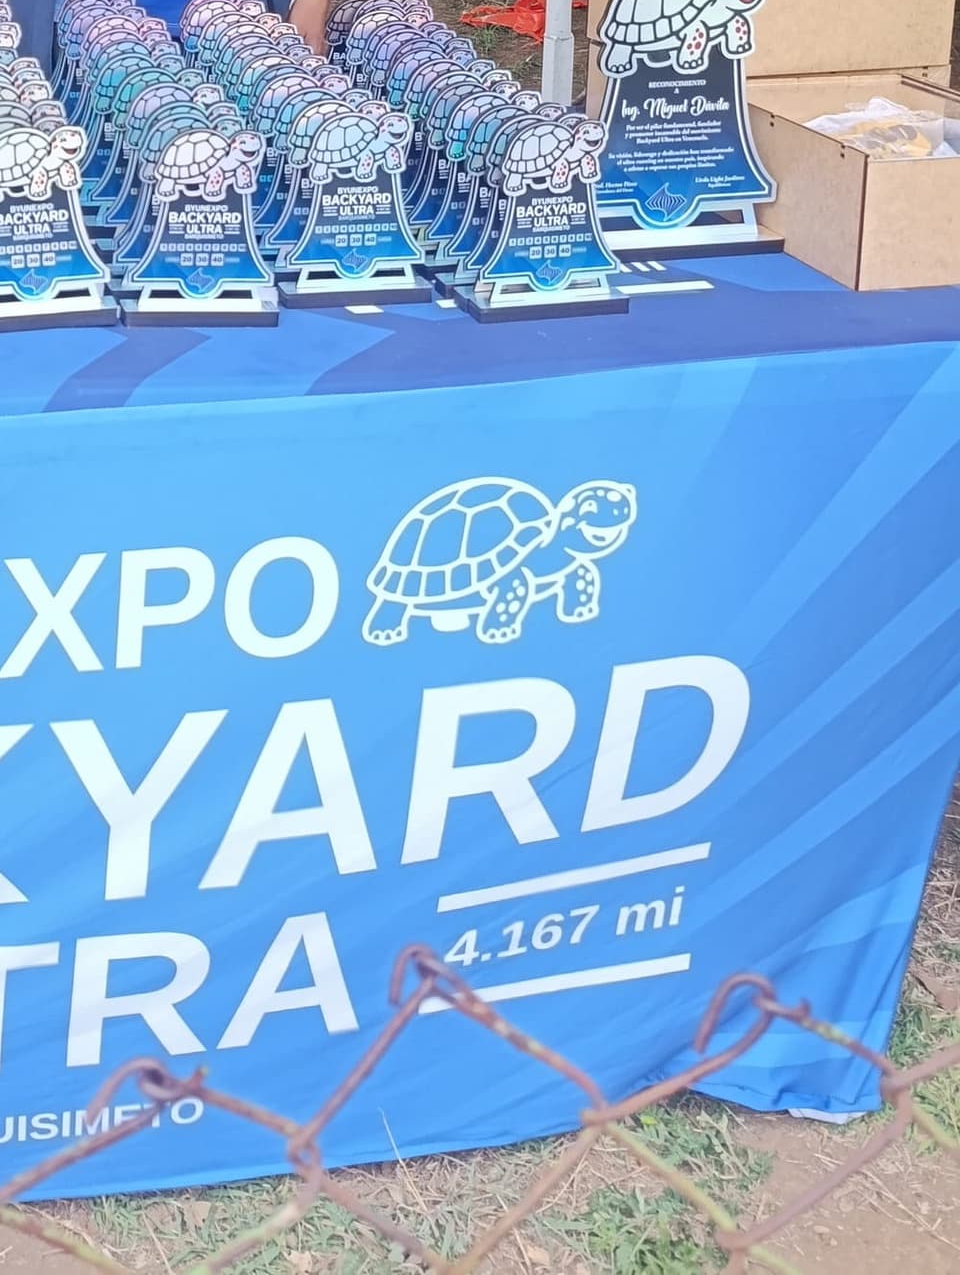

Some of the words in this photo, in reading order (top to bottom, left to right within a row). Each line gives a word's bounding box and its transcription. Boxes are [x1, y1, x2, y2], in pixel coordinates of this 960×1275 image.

[643, 97, 688, 119] Miguel
[322, 193, 392, 206] BACKYARD
[339, 205, 374, 215] ULTRA
[515, 202, 587, 218] BACKYARD
[168, 211, 242, 224] BACKYARD
[533, 215, 569, 227] ULTRA
[13, 222, 51, 235] ULTRA
[186, 224, 222, 234] ULTRA
[443, 903, 600, 967] 4.167
[615, 885, 686, 936] mi
